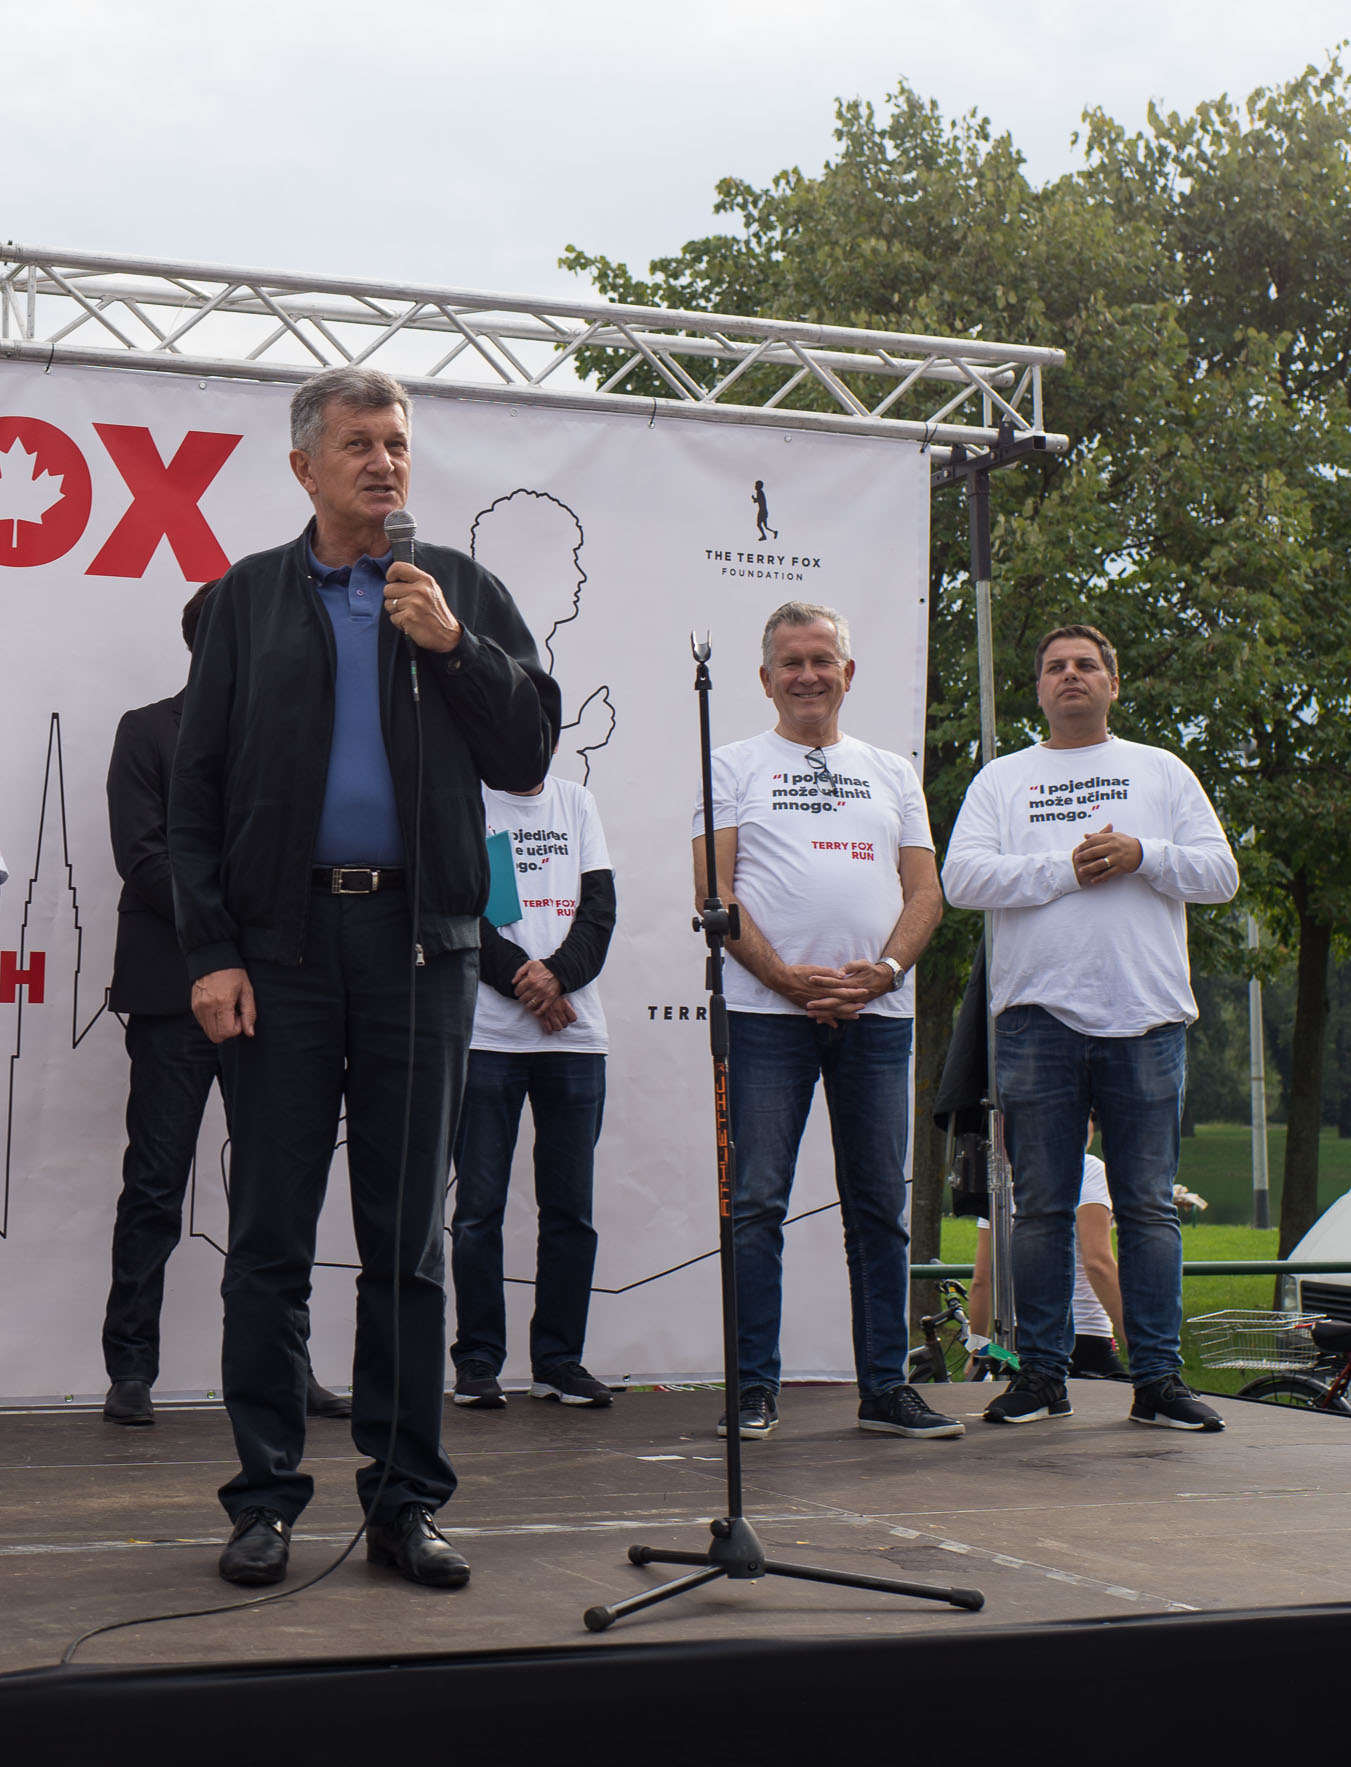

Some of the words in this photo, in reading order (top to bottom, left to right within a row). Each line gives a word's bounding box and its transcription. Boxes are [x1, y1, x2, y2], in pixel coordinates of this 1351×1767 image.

[705, 549, 732, 562] THE
[737, 552, 785, 565] TERRY
[791, 556, 821, 568] FOX
[721, 567, 803, 581] FOUNDATION
[792, 771, 870, 788] pojedinac
[1048, 776, 1130, 795] pojedinac
[772, 786, 818, 797] može
[1029, 796, 1073, 809] može
[1076, 789, 1128, 805] učiniti
[811, 841, 848, 851] TERRY
[851, 842, 874, 852] FOX
[851, 851, 875, 861] RUN
[555, 899, 575, 908] FOX
[648, 1006, 708, 1020] TERR
[715, 1075, 731, 1217] ATHLETIC
